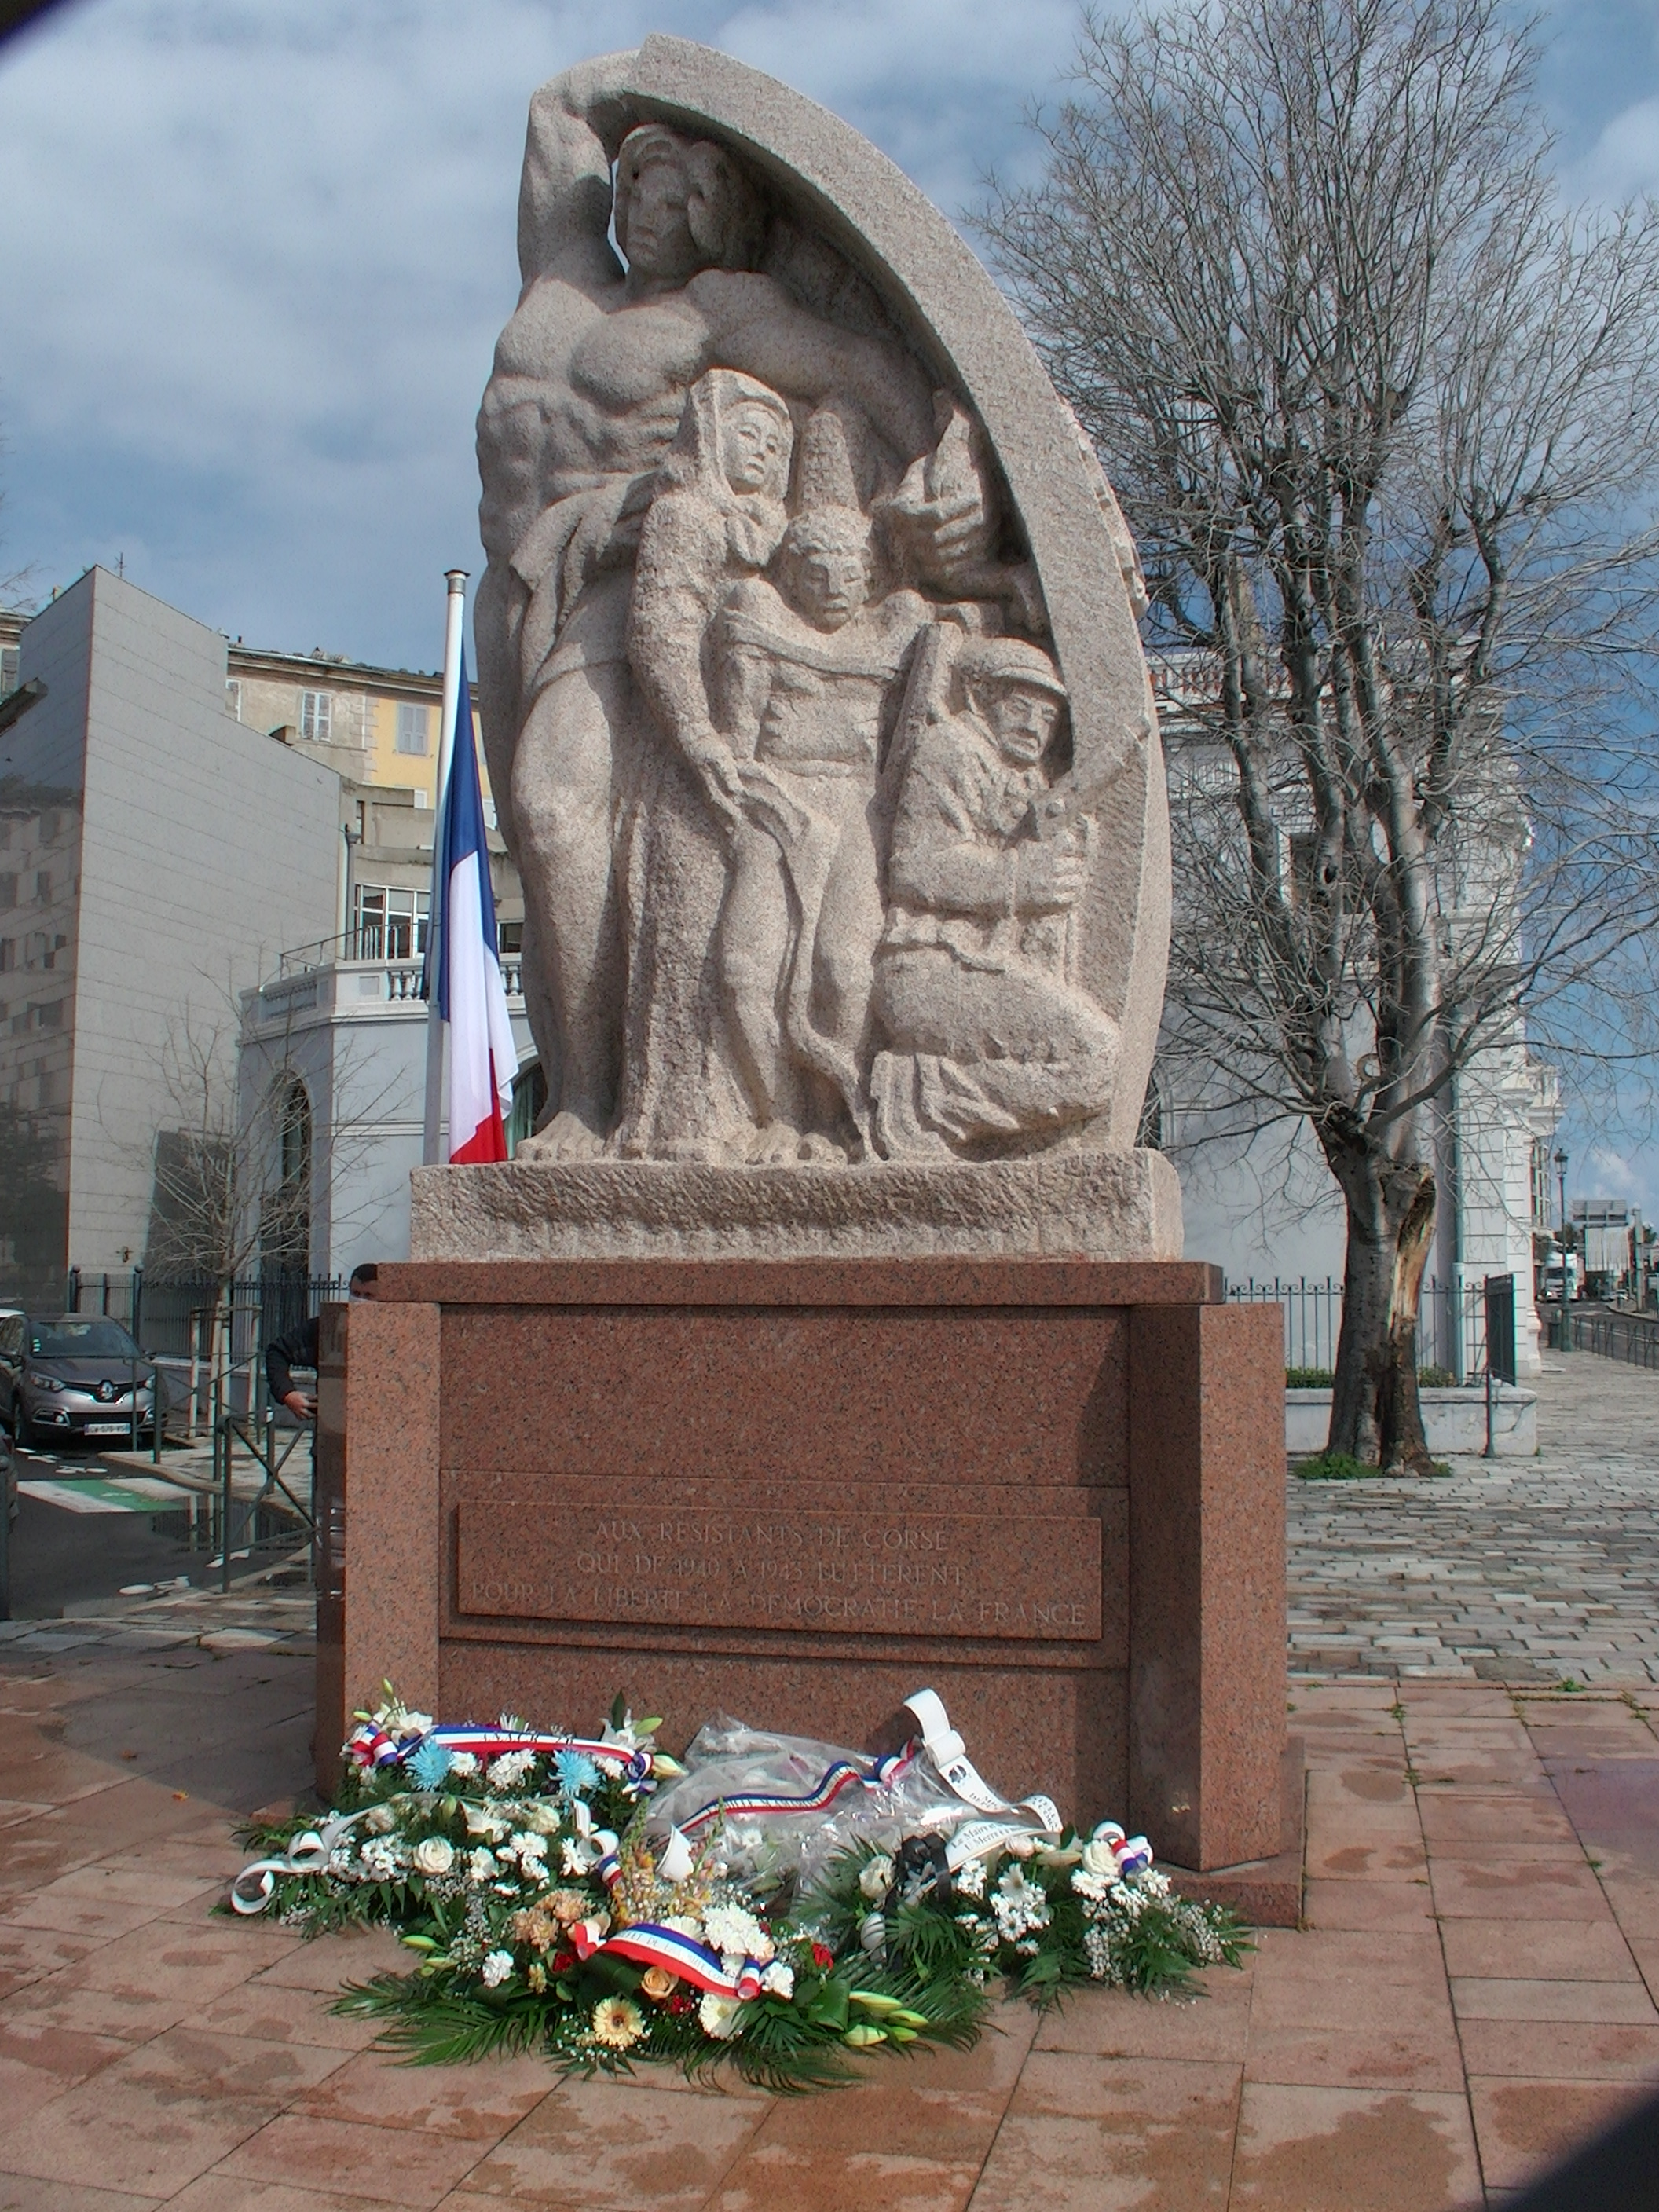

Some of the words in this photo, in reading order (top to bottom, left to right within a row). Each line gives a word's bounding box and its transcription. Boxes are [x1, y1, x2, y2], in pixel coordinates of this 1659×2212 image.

[597, 1519, 641, 1540] AUX
[661, 1521, 803, 1547] RESISTANTS
[819, 1526, 849, 1547] DE
[864, 1529, 948, 1551] CORSE
[577, 1552, 619, 1573] QUI
[635, 1554, 665, 1574] DE
[676, 1558, 720, 1578] 1940
[761, 1561, 803, 1581] 1945
[818, 1562, 967, 1586] LUTTERENT
[472, 1581, 533, 1603] POUR
[594, 1587, 688, 1610] LIBERTE
[749, 1593, 918, 1620] DEMOCRATIE
[932, 1599, 963, 1621] LA
[980, 1601, 1086, 1625] FRANCE
